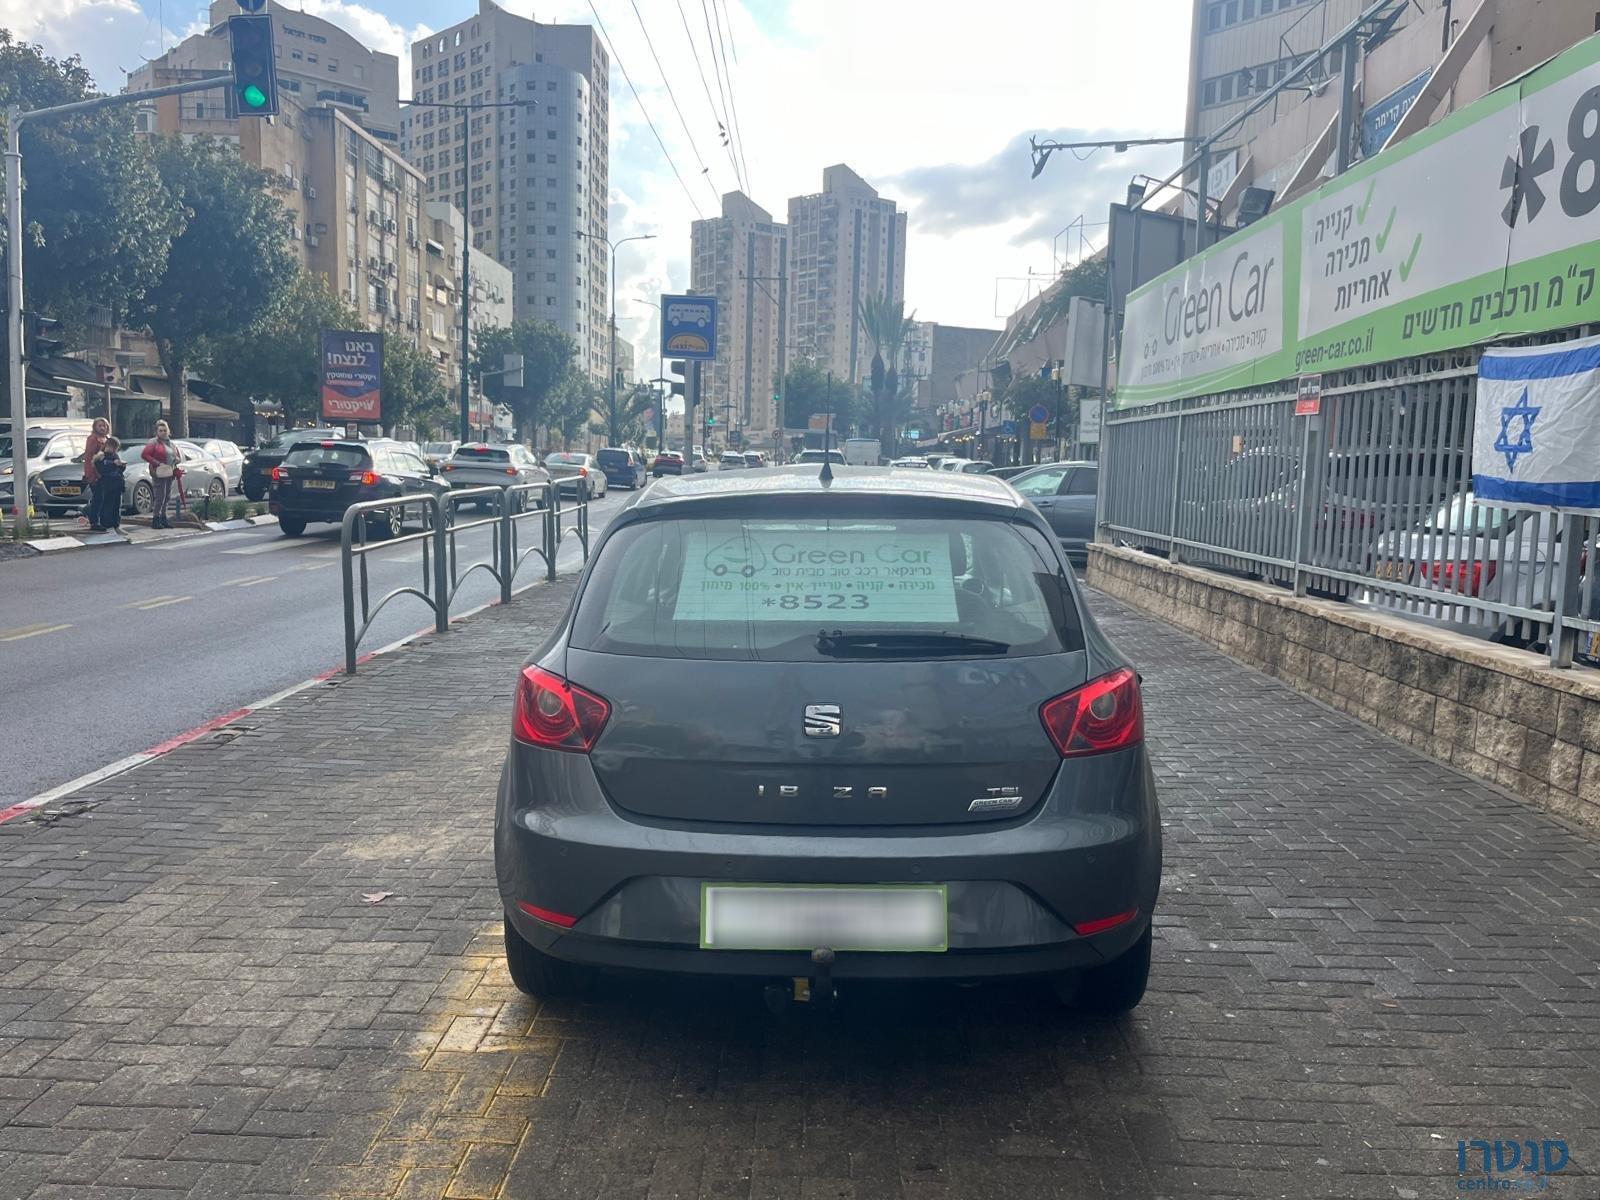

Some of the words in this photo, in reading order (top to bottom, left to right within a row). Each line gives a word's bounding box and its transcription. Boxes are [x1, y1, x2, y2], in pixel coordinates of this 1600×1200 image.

[1375, 104, 1400, 130] קדימה
[1314, 204, 1353, 245] קנייה
[1325, 236, 1370, 277] מכירה
[1334, 269, 1392, 312] אחריות
[1546, 263, 1595, 309] ק"מ
[1164, 282, 1222, 346] Green
[1229, 251, 1274, 322] Car
[1469, 282, 1539, 325] ורכבים
[1402, 302, 1463, 340] חדשים
[345, 341, 375, 353] באנו
[1295, 327, 1375, 367] green-car.co.il
[327, 352, 367, 366] לנצח!
[772, 543, 865, 564] Green
[876, 543, 931, 564] Car
[772, 567, 791, 577] טוב
[796, 567, 824, 577] מבית
[830, 567, 850, 576] טוב
[855, 567, 878, 576] רכב
[701, 580, 733, 592] מימון
[739, 581, 770, 591] 100%
[857, 581, 884, 592] קניה
[899, 580, 935, 590] מכירה
[987, 786, 1019, 796] TSI
